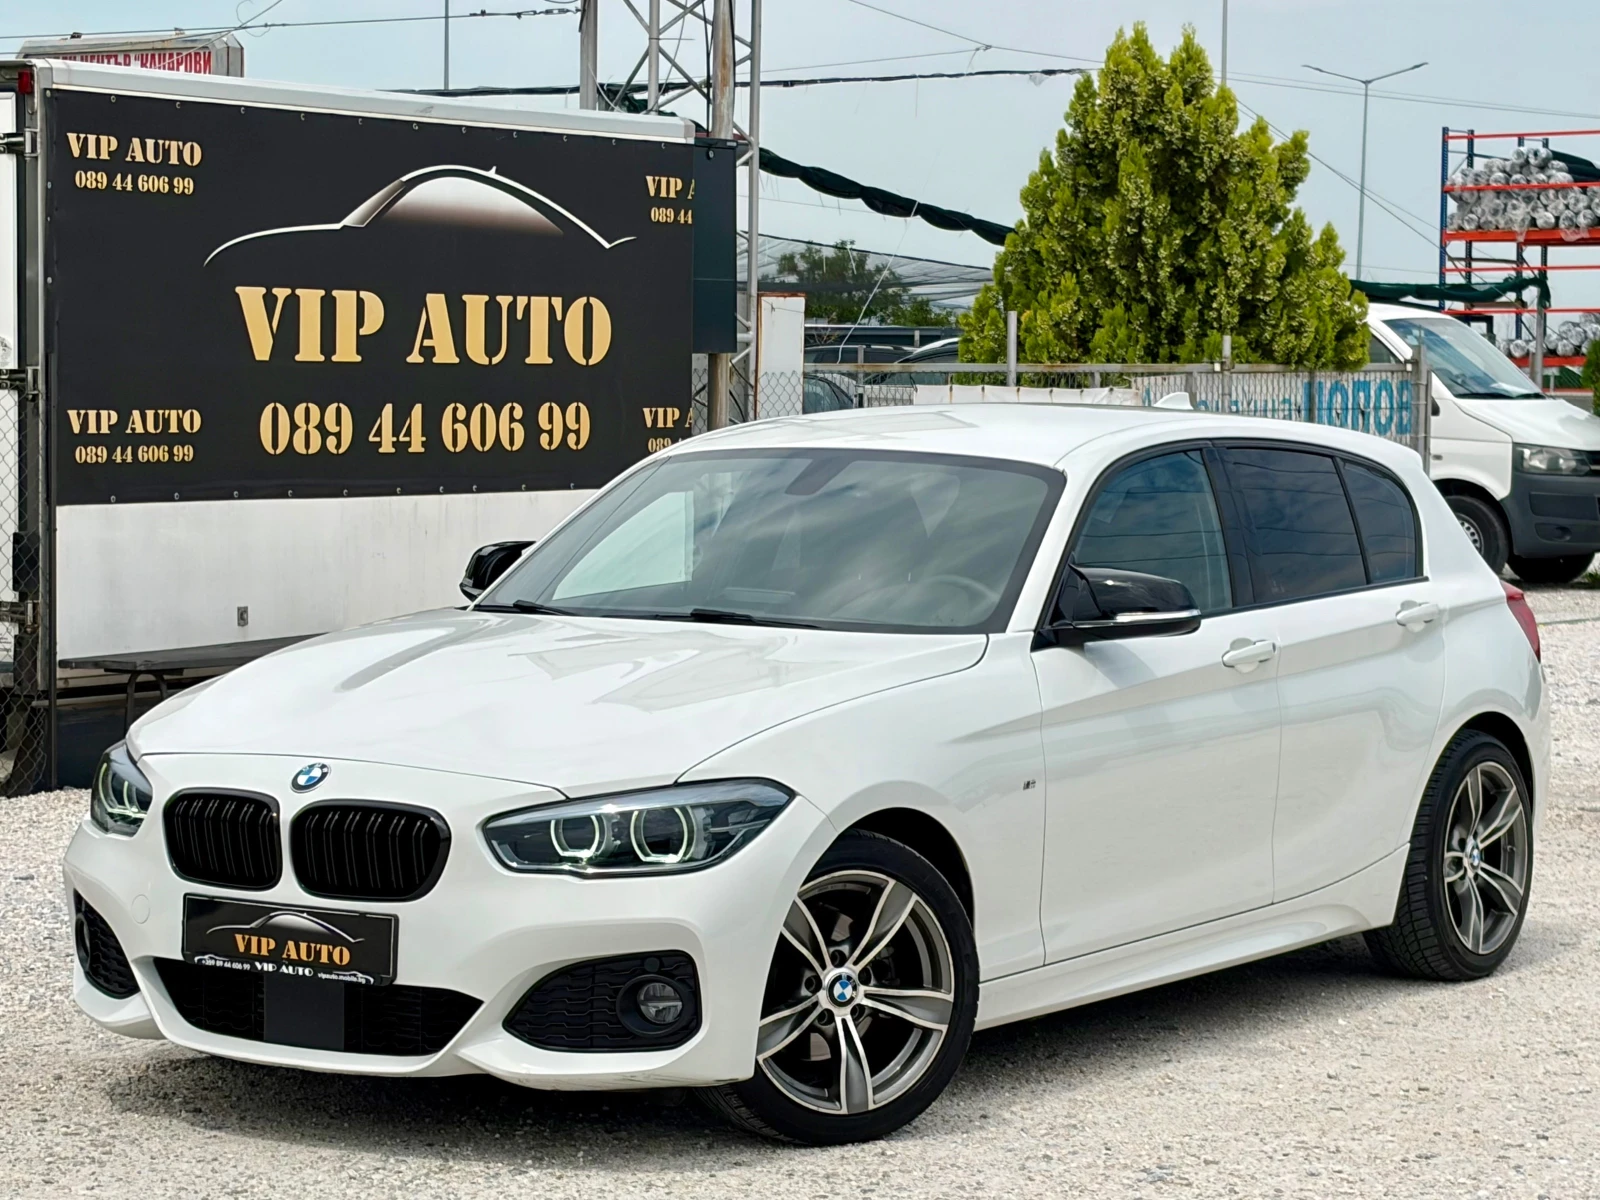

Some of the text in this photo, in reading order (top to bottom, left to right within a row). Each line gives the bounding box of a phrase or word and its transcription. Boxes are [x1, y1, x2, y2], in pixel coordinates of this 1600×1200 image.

[67, 132, 202, 167] VIP AUTO
[74, 171, 194, 195] 089 44 606 99
[646, 175, 683, 199] VIP
[650, 207, 693, 225] 089 44
[235, 286, 612, 366] VIP AUTO
[67, 409, 202, 434] VIP AUTO
[259, 401, 591, 455] 089 44 606 99
[642, 407, 680, 428] VIP
[74, 444, 194, 464] 089 44 606 99
[234, 933, 351, 966] VIP AUTO
[254, 961, 277, 972] VIP
[279, 964, 314, 977] AUTO
